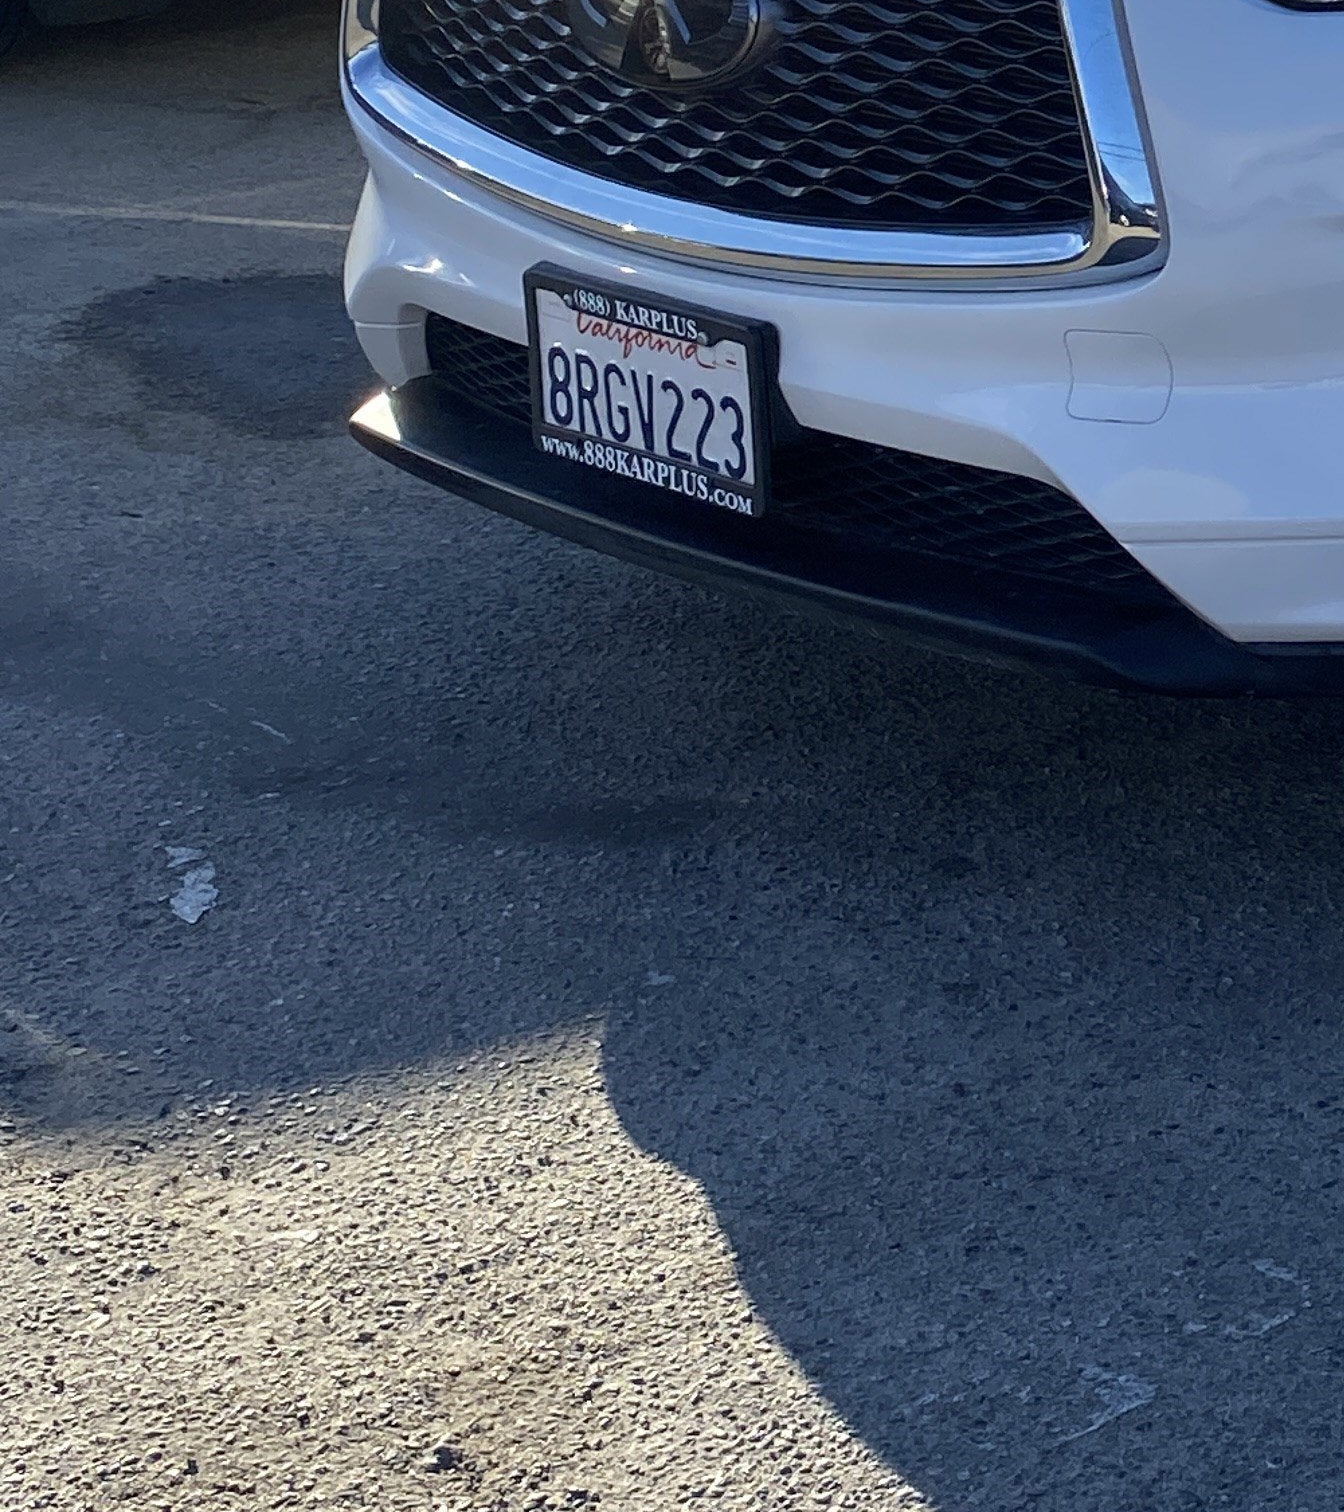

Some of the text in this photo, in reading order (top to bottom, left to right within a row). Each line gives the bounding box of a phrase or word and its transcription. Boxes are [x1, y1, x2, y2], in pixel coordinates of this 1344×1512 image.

[573, 289, 698, 340] (888) KARPLUS
[547, 343, 747, 480] 8RGV223
